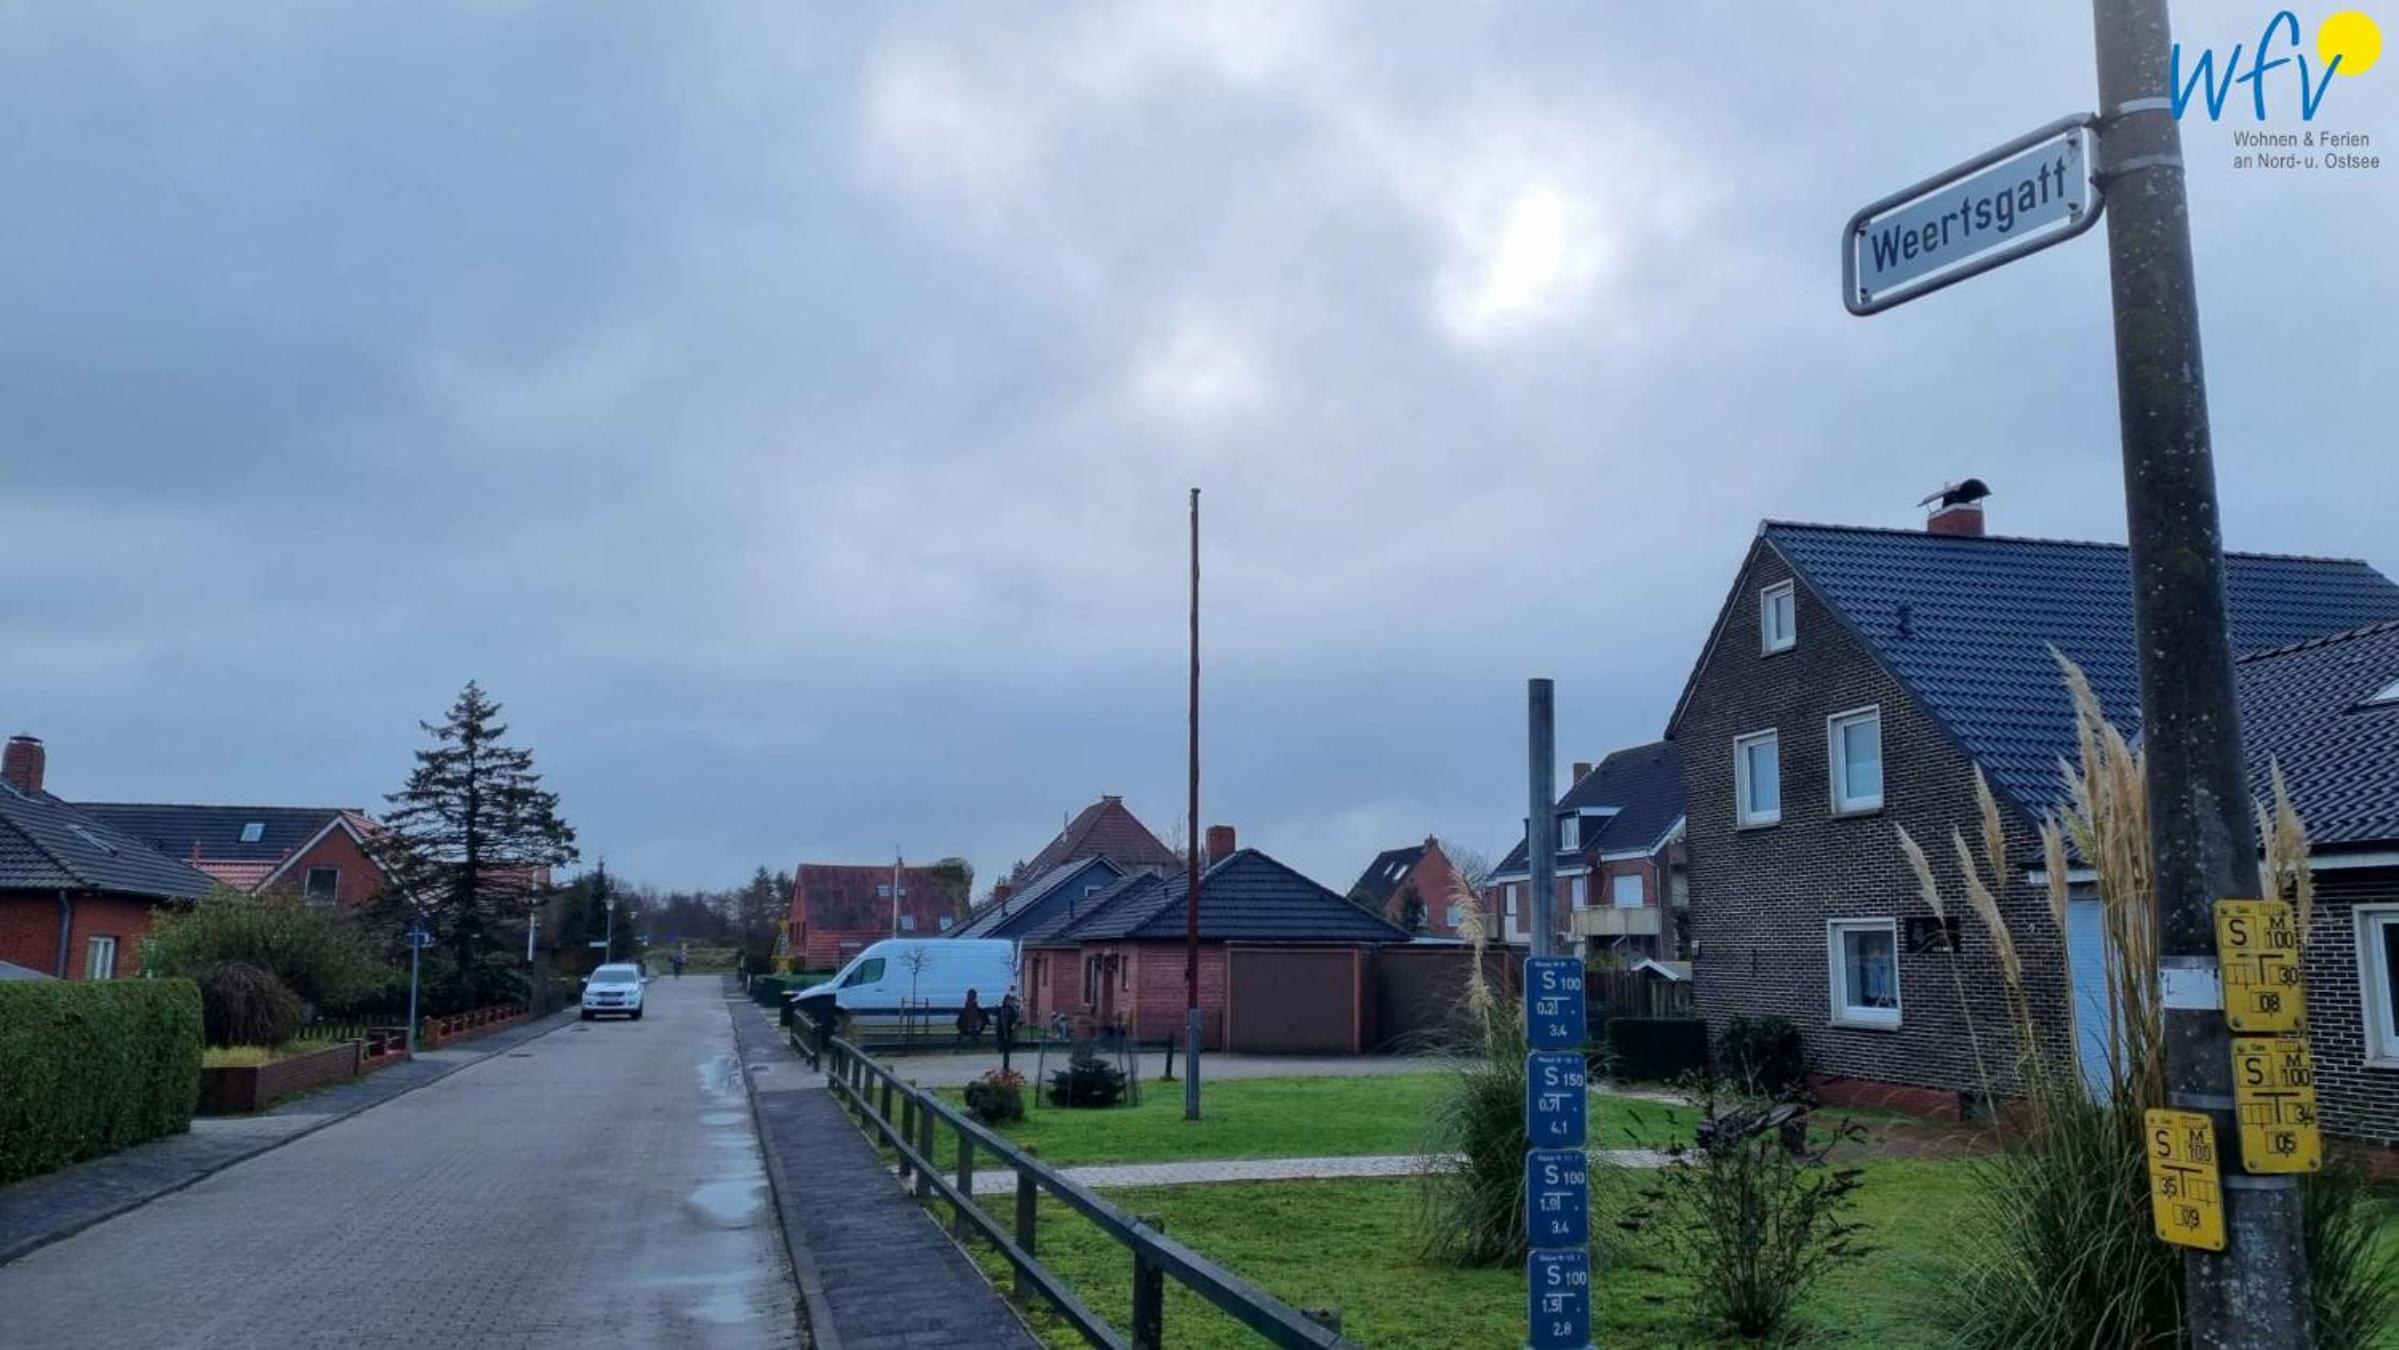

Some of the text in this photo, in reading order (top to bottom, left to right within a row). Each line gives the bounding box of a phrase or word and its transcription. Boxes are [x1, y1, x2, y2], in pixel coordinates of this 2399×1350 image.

[1872, 155, 2067, 274] Weertsgatt
[2229, 918, 2248, 946] S
[2269, 915, 2285, 929] M
[2266, 931, 2294, 949] 100
[1542, 970, 1581, 990] S 100
[2286, 1054, 2301, 1066] M
[1544, 1066, 1584, 1087] S 150
[2245, 1057, 2263, 1086] S
[2283, 1068, 2310, 1087] 100
[2156, 1129, 2171, 1157] S
[2189, 1130, 2203, 1141] M
[1545, 1164, 1586, 1185] S 100
[1547, 1264, 1587, 1286] S 100
